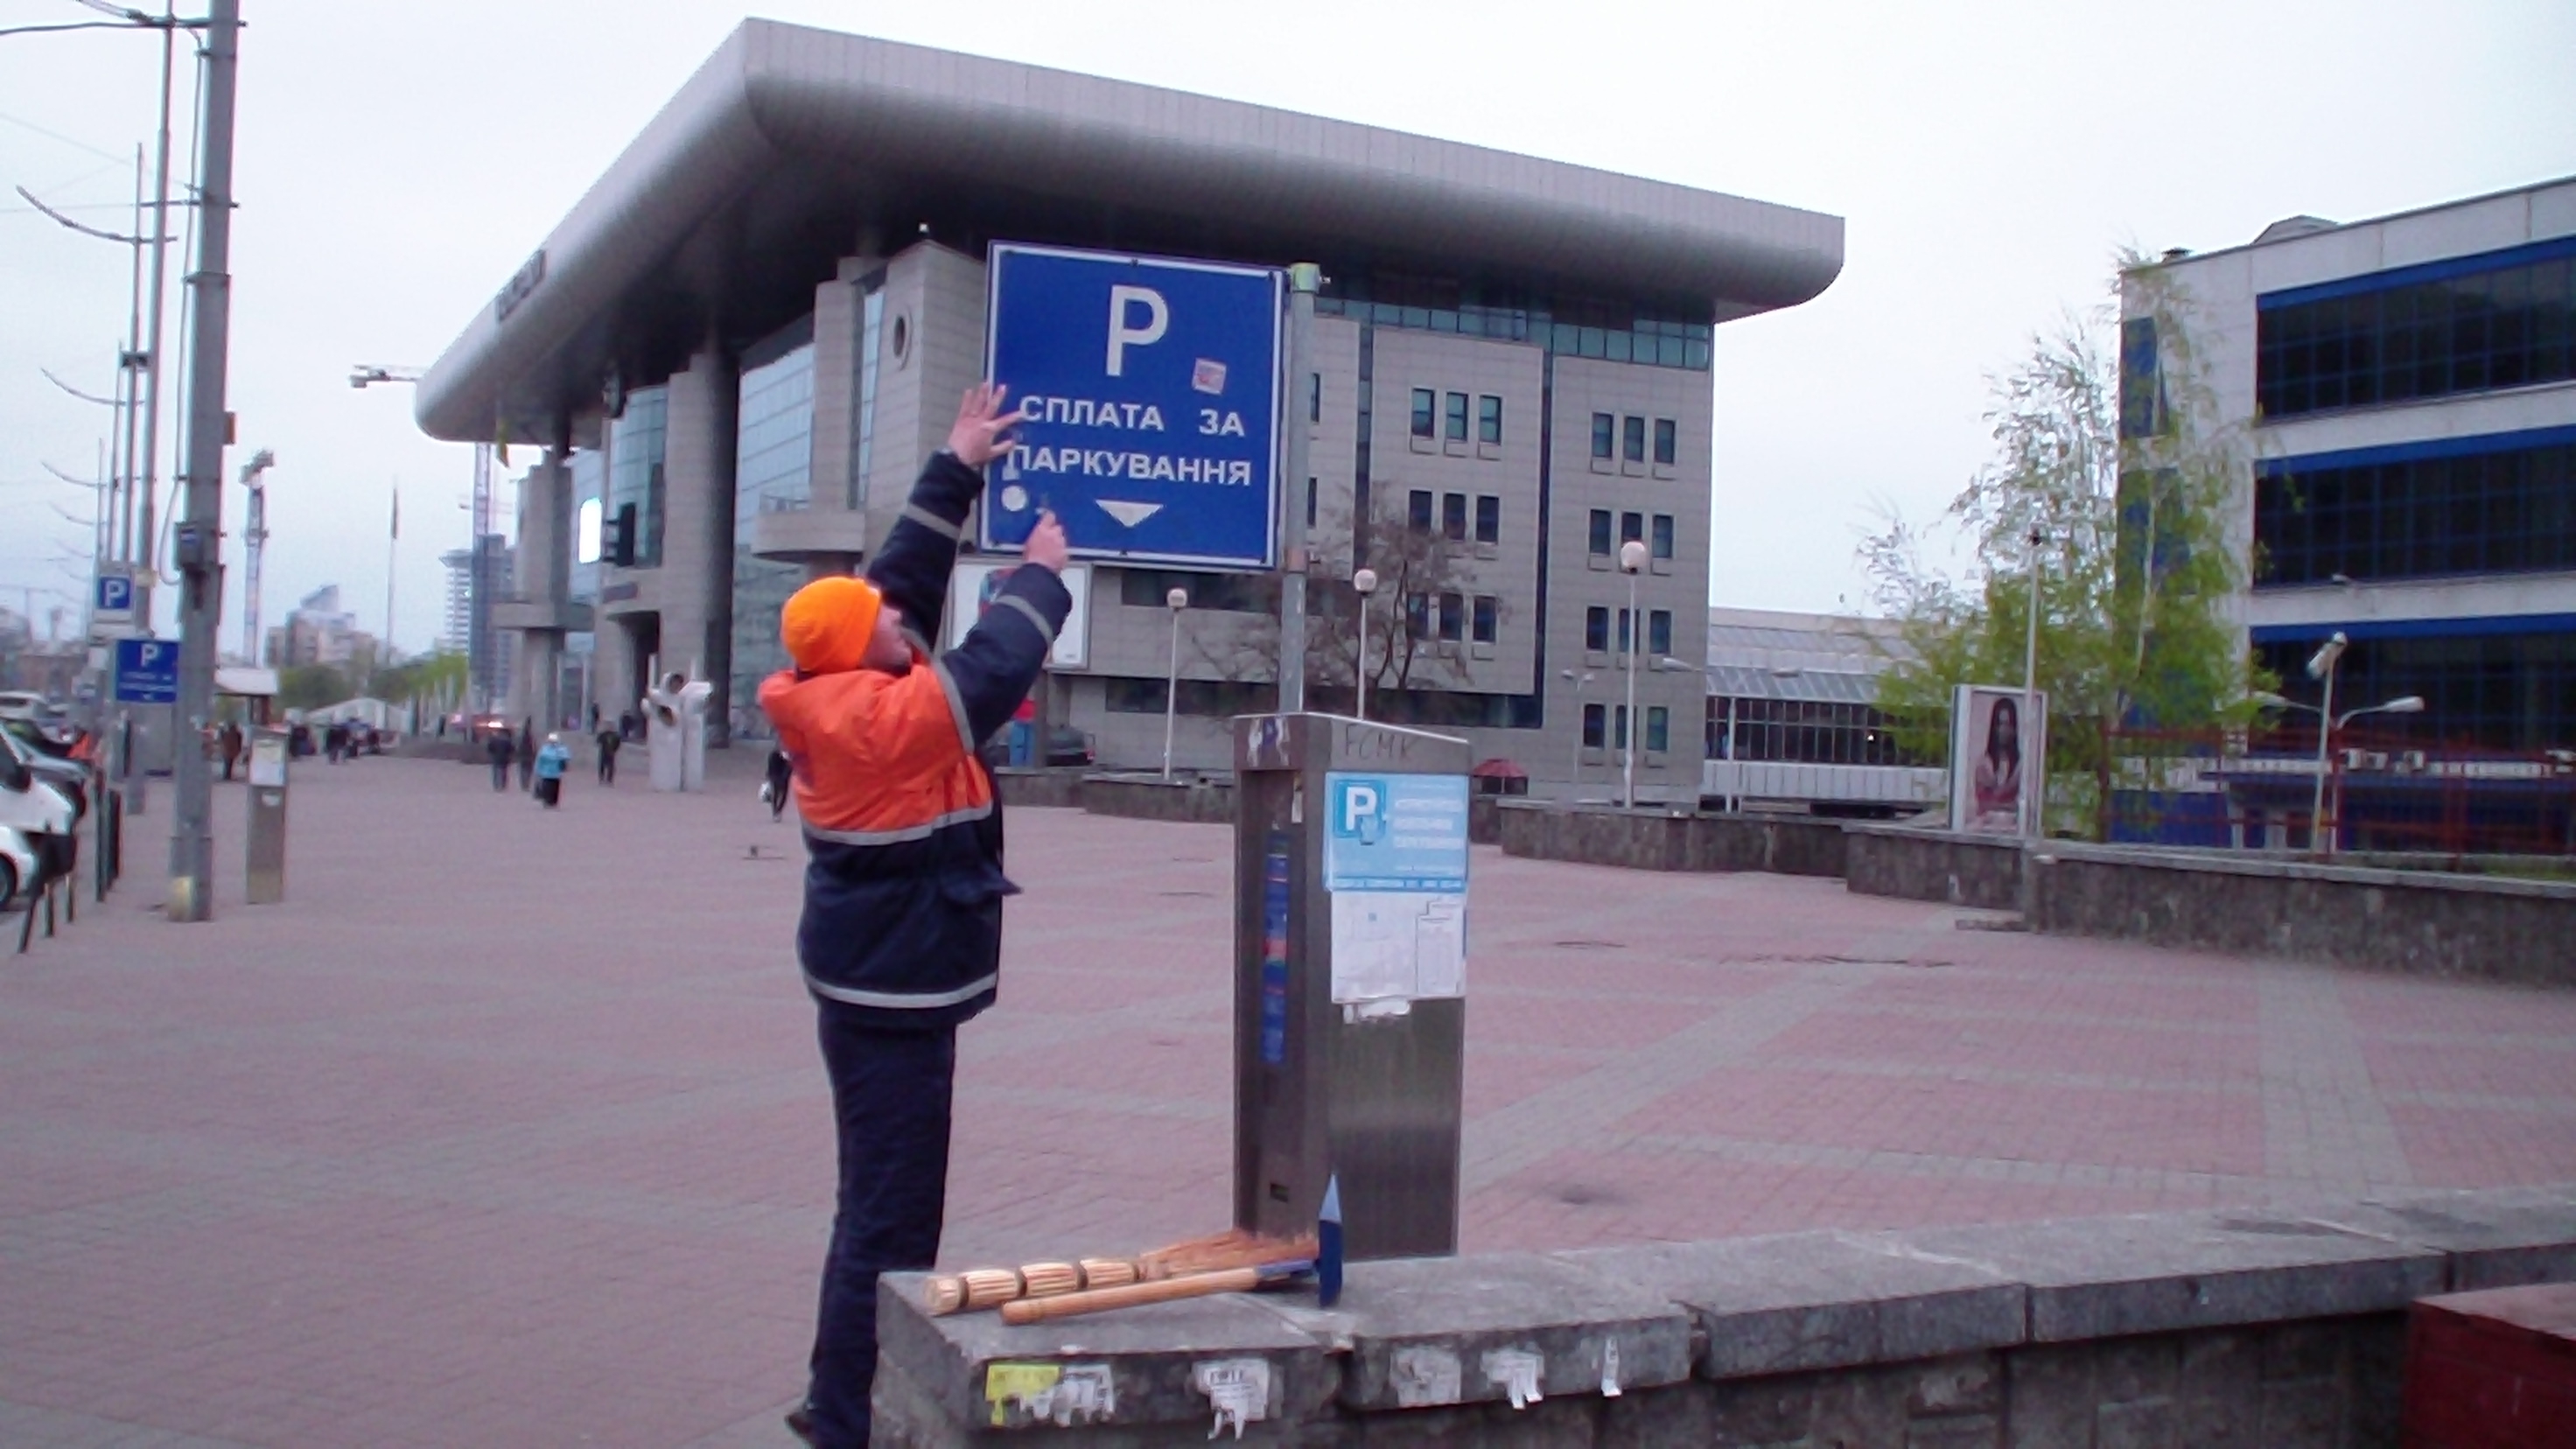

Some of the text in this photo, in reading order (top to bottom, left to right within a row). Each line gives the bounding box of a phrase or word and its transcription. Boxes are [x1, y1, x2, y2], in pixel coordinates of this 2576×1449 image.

[1106, 284, 1169, 377] P
[1019, 396, 1245, 437] СПЛАТА ЗА
[1007, 444, 1252, 486] ПАРКУВАННЯ
[104, 580, 127, 607] P
[140, 643, 158, 668] P
[1346, 787, 1377, 831] P
